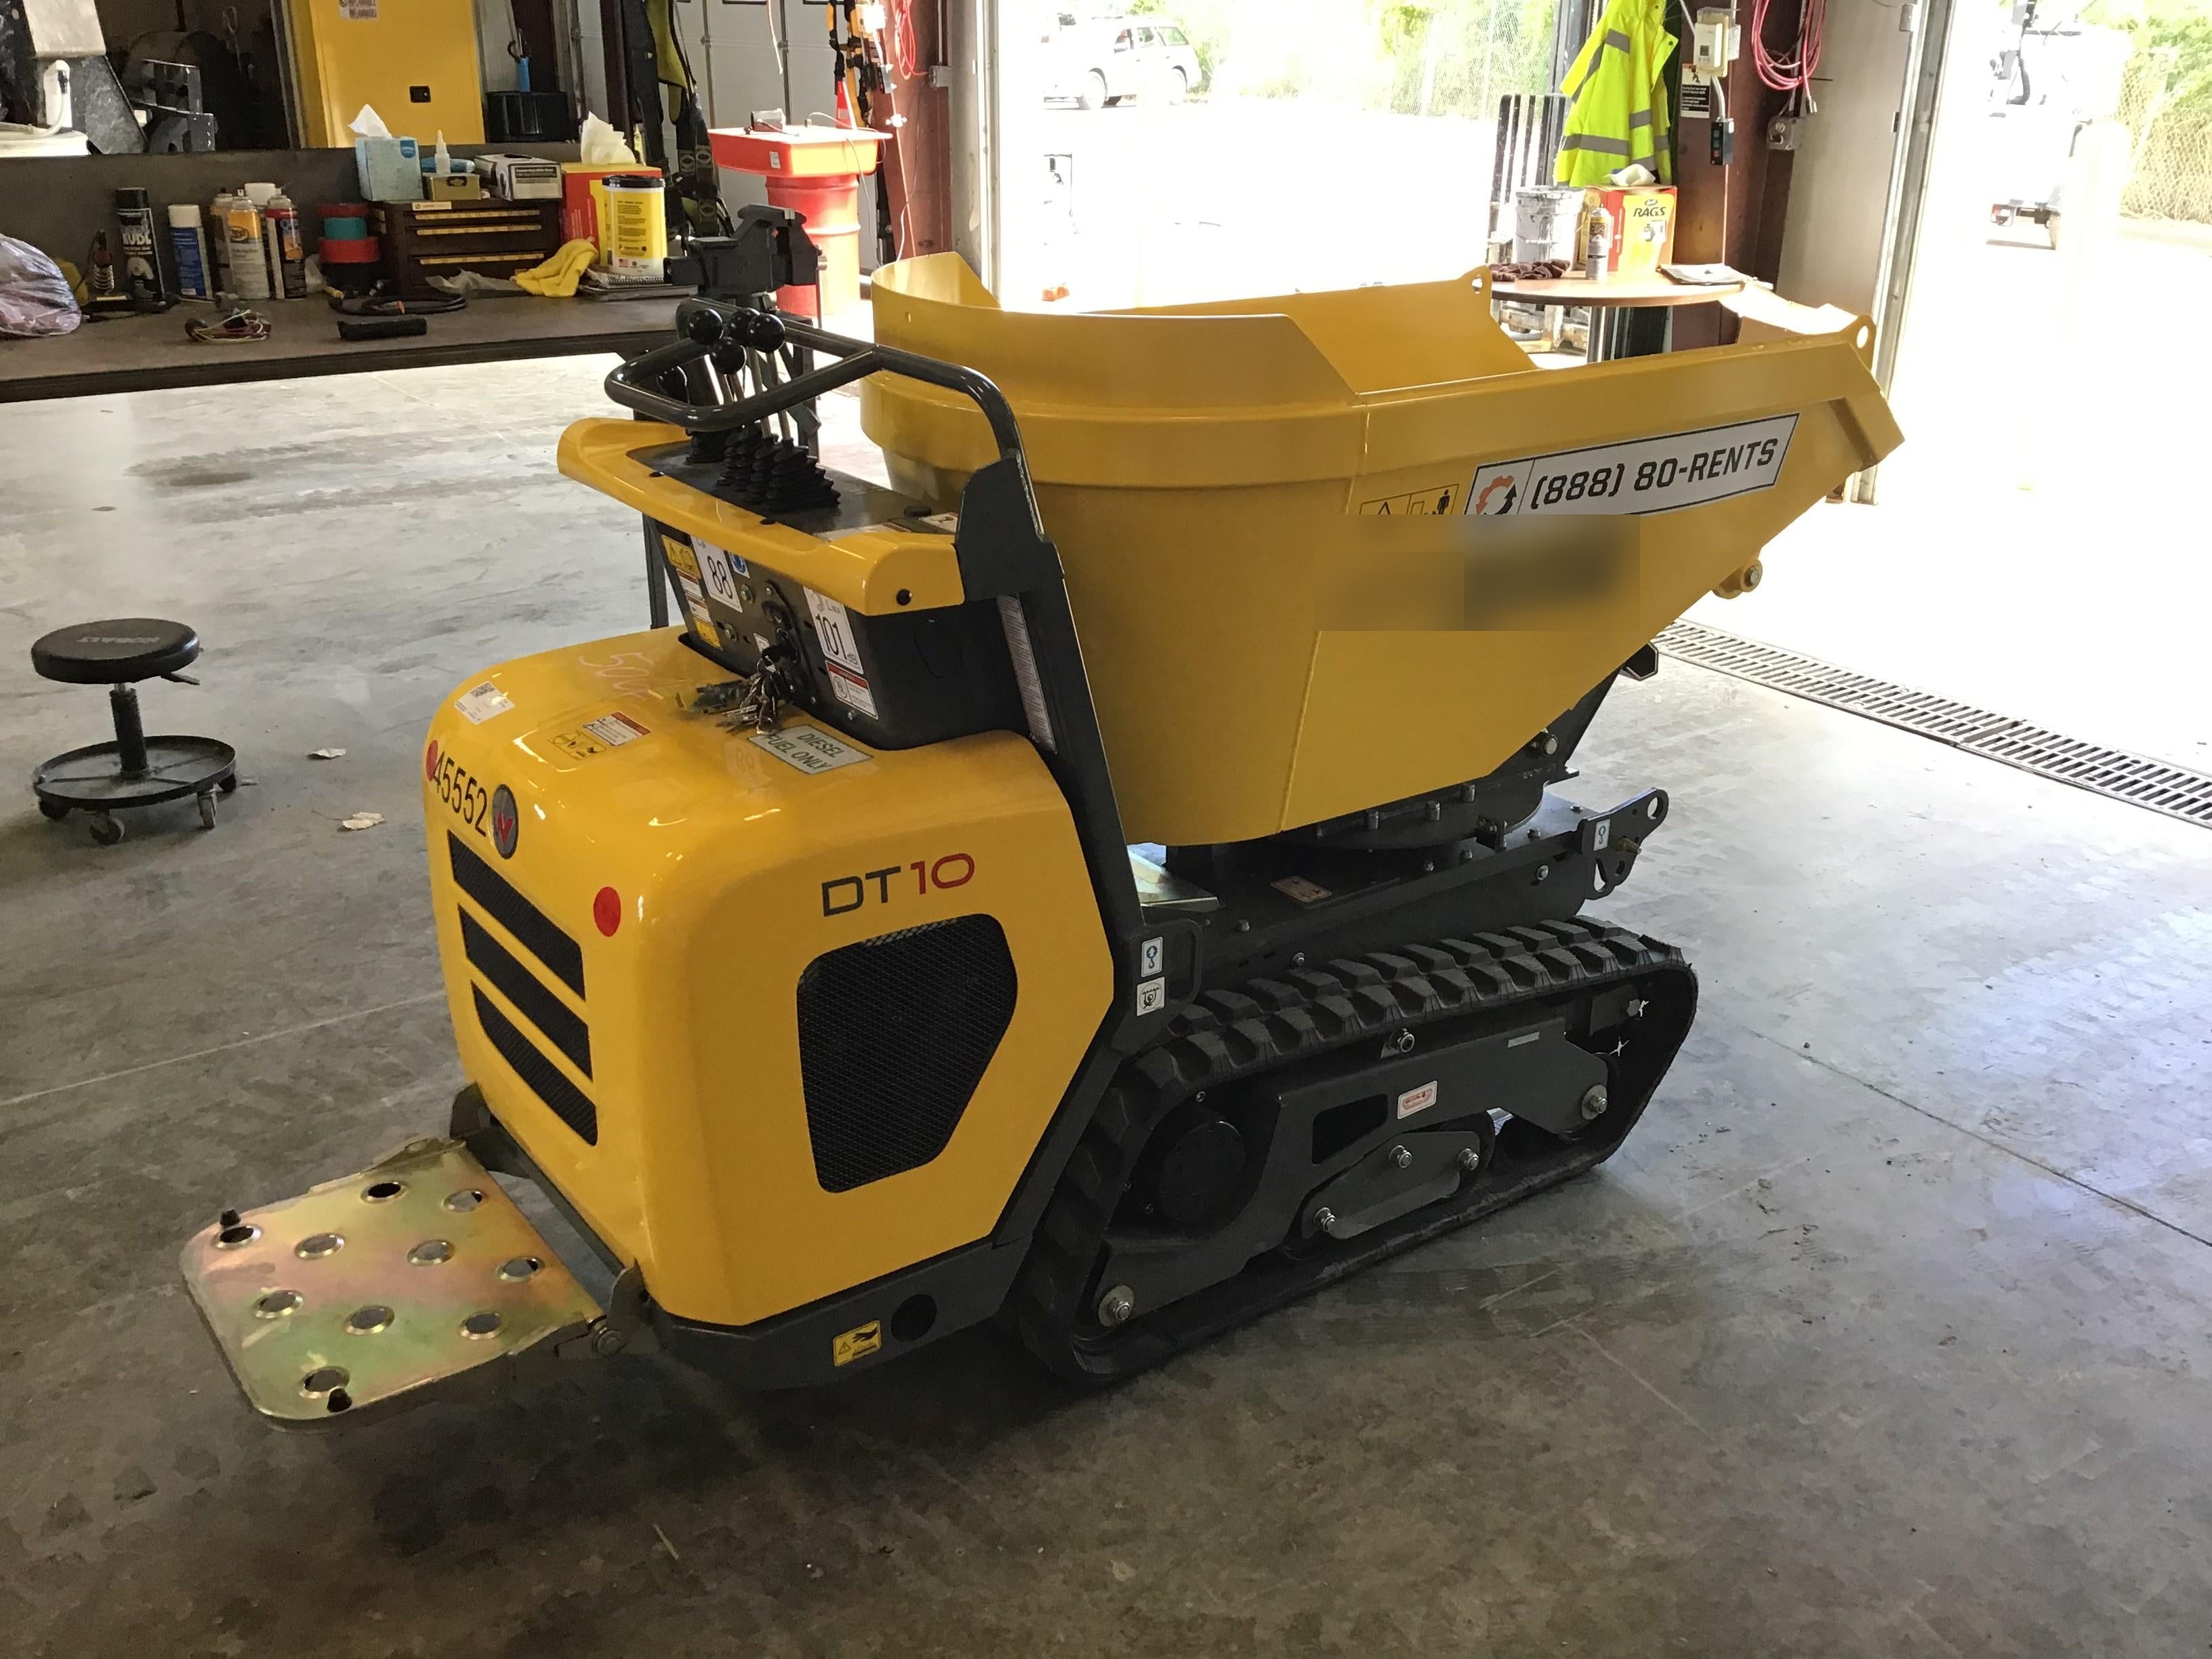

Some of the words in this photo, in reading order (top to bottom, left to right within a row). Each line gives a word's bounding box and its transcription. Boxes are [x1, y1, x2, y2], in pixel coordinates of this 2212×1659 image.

[1633, 206, 1666, 218] RAGS
[1530, 463, 1625, 510] (888)
[1633, 438, 1778, 491] 80-RENTS
[707, 555, 733, 599] 88
[815, 613, 848, 659] 101
[763, 733, 798, 754] FUEL
[790, 750, 833, 770] ONLY
[797, 733, 846, 758] DIESEL
[433, 750, 488, 838] 45552
